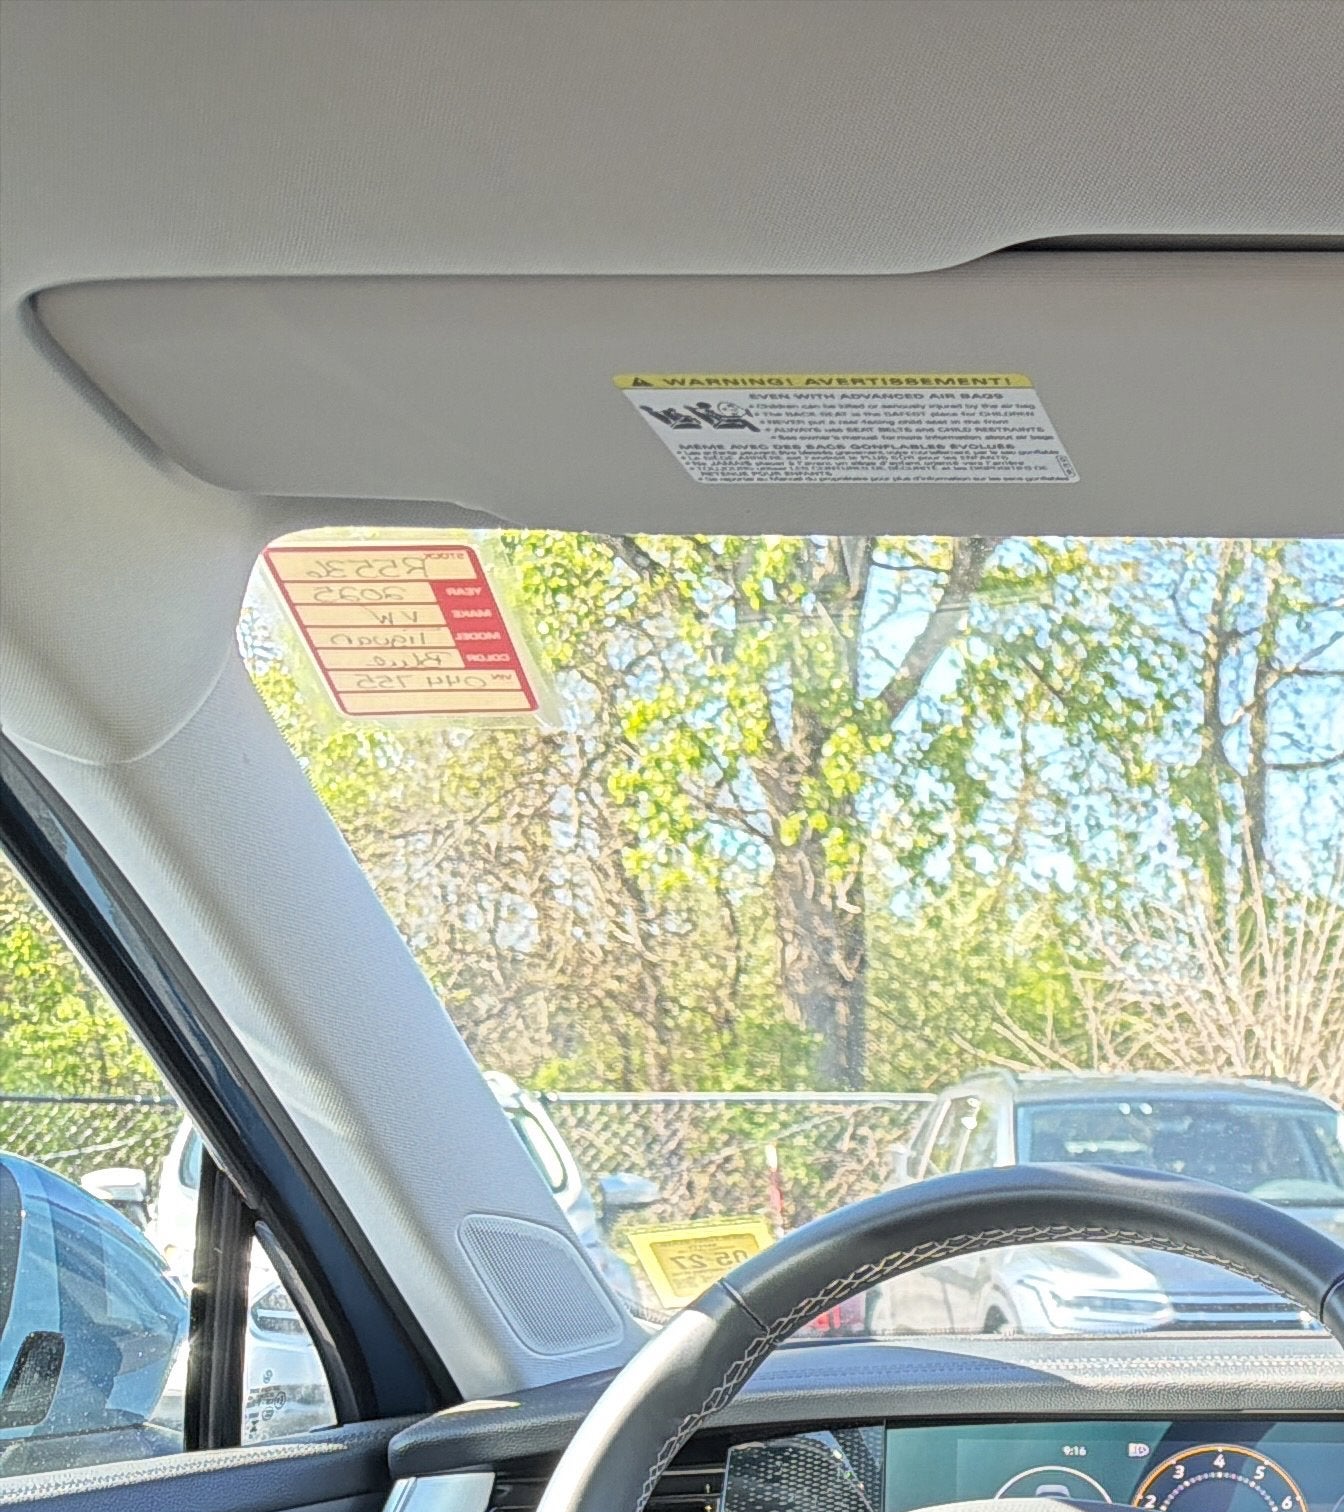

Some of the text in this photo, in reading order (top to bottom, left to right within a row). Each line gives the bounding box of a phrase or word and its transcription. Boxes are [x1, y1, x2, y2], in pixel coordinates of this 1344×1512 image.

[662, 377, 1012, 386] WARNING! AVERTISSEMENT!
[1063, 1446, 1087, 1456] 9:16
[1213, 1454, 1226, 1468] 4
[1173, 1465, 1185, 1479] 3
[1253, 1466, 1266, 1480] 5
[1144, 1495, 1157, 1508] 2
[1281, 1495, 1293, 1510] 6
